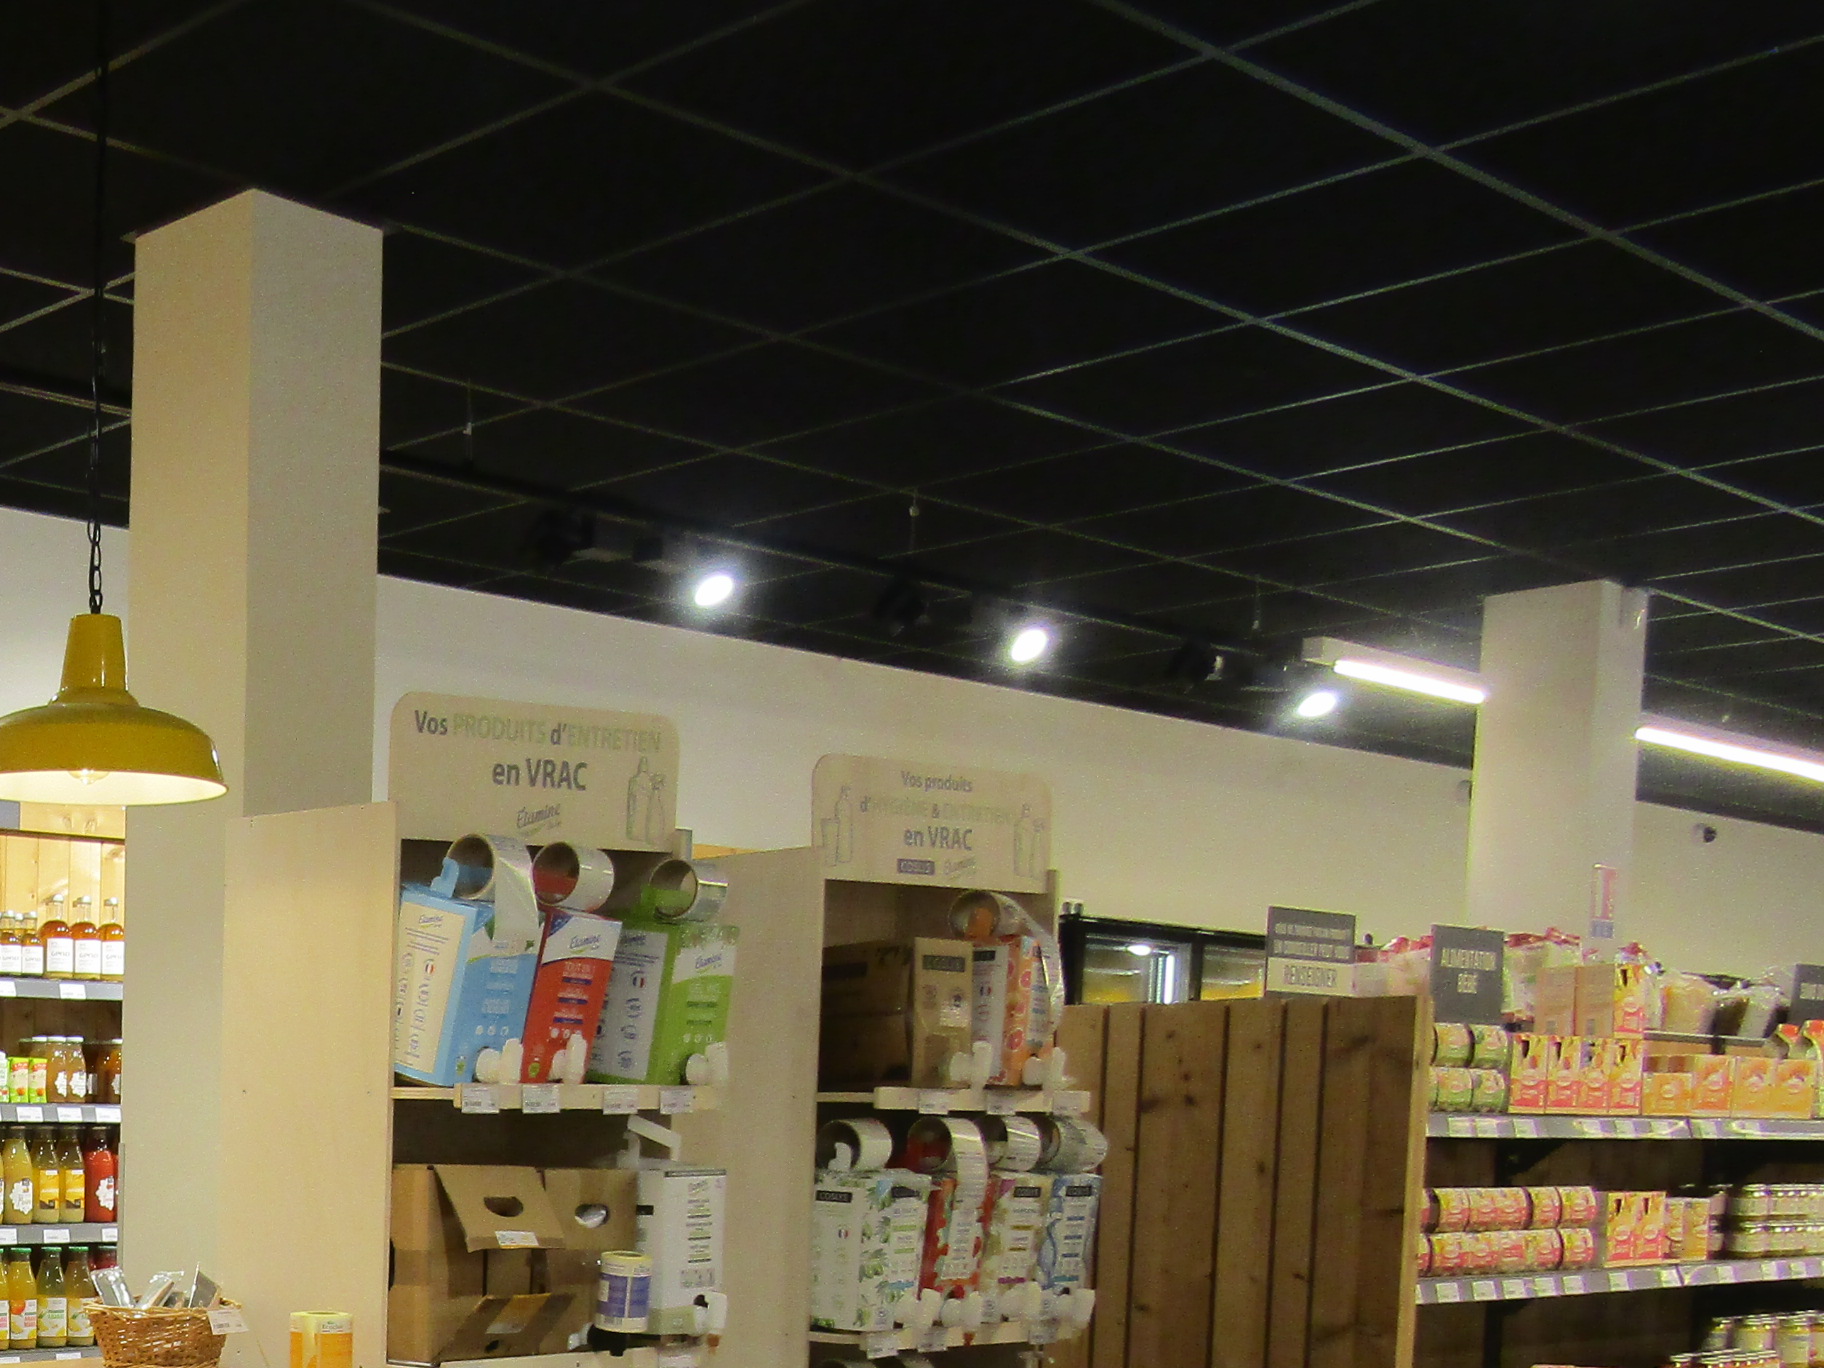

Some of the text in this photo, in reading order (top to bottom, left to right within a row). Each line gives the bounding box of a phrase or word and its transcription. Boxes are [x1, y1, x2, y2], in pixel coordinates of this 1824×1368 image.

[414, 709, 662, 752] Vos PRODUITS d'ENTRETIEN
[491, 758, 588, 791] en VRAC
[900, 770, 973, 793] Vos produits
[903, 826, 973, 850] en VRAC
